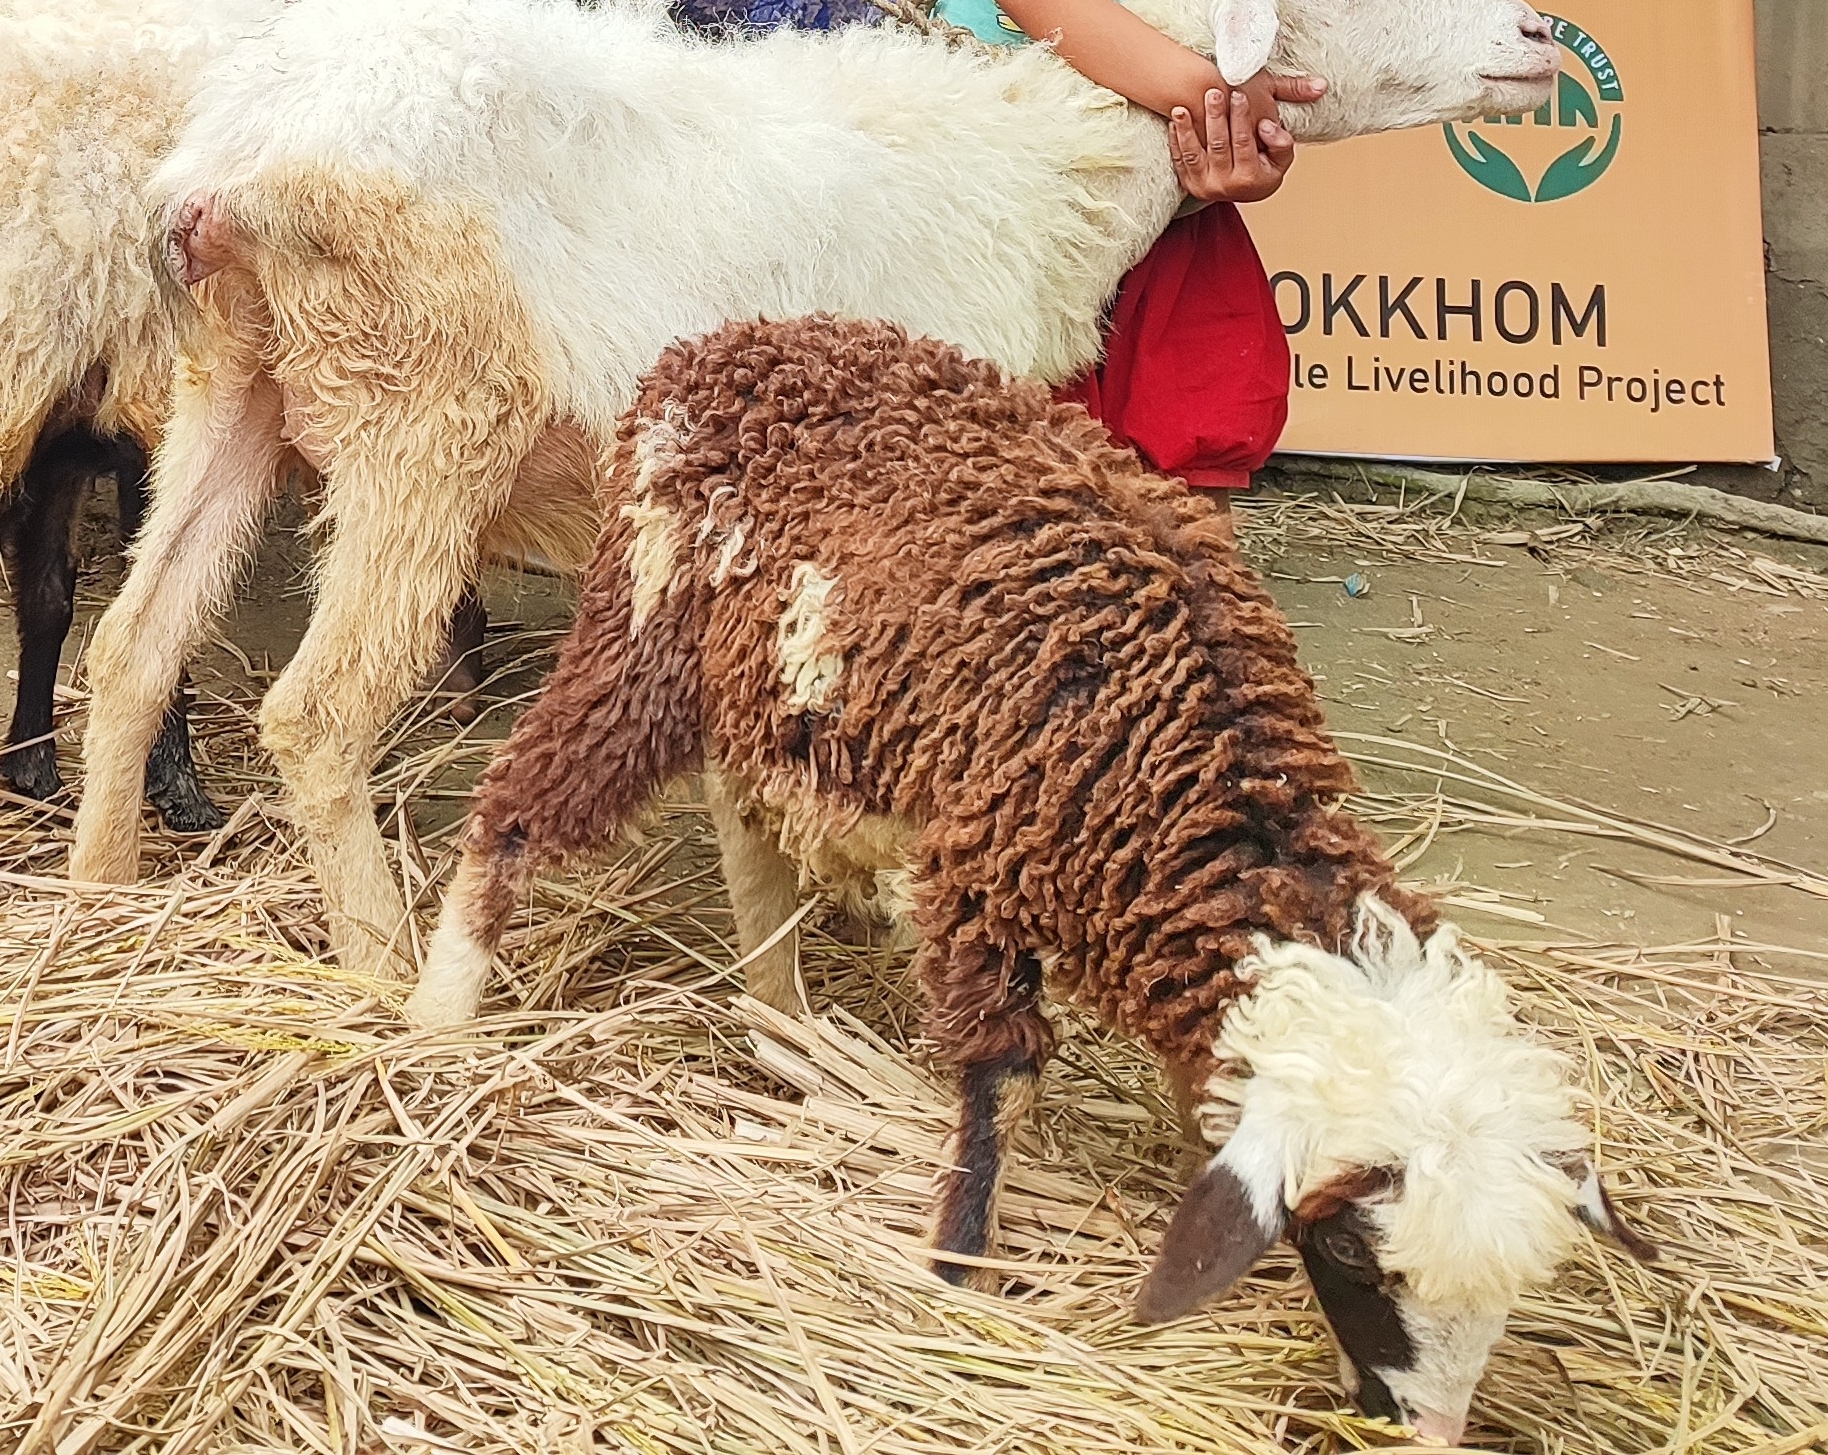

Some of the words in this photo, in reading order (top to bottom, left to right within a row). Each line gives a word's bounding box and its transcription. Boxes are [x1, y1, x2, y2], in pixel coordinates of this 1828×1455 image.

[1572, 31, 1620, 91] TRUST
[1268, 269, 1608, 348] OKKHOM
[1346, 355, 1560, 400] Livelihood
[1579, 364, 1727, 414] Project
